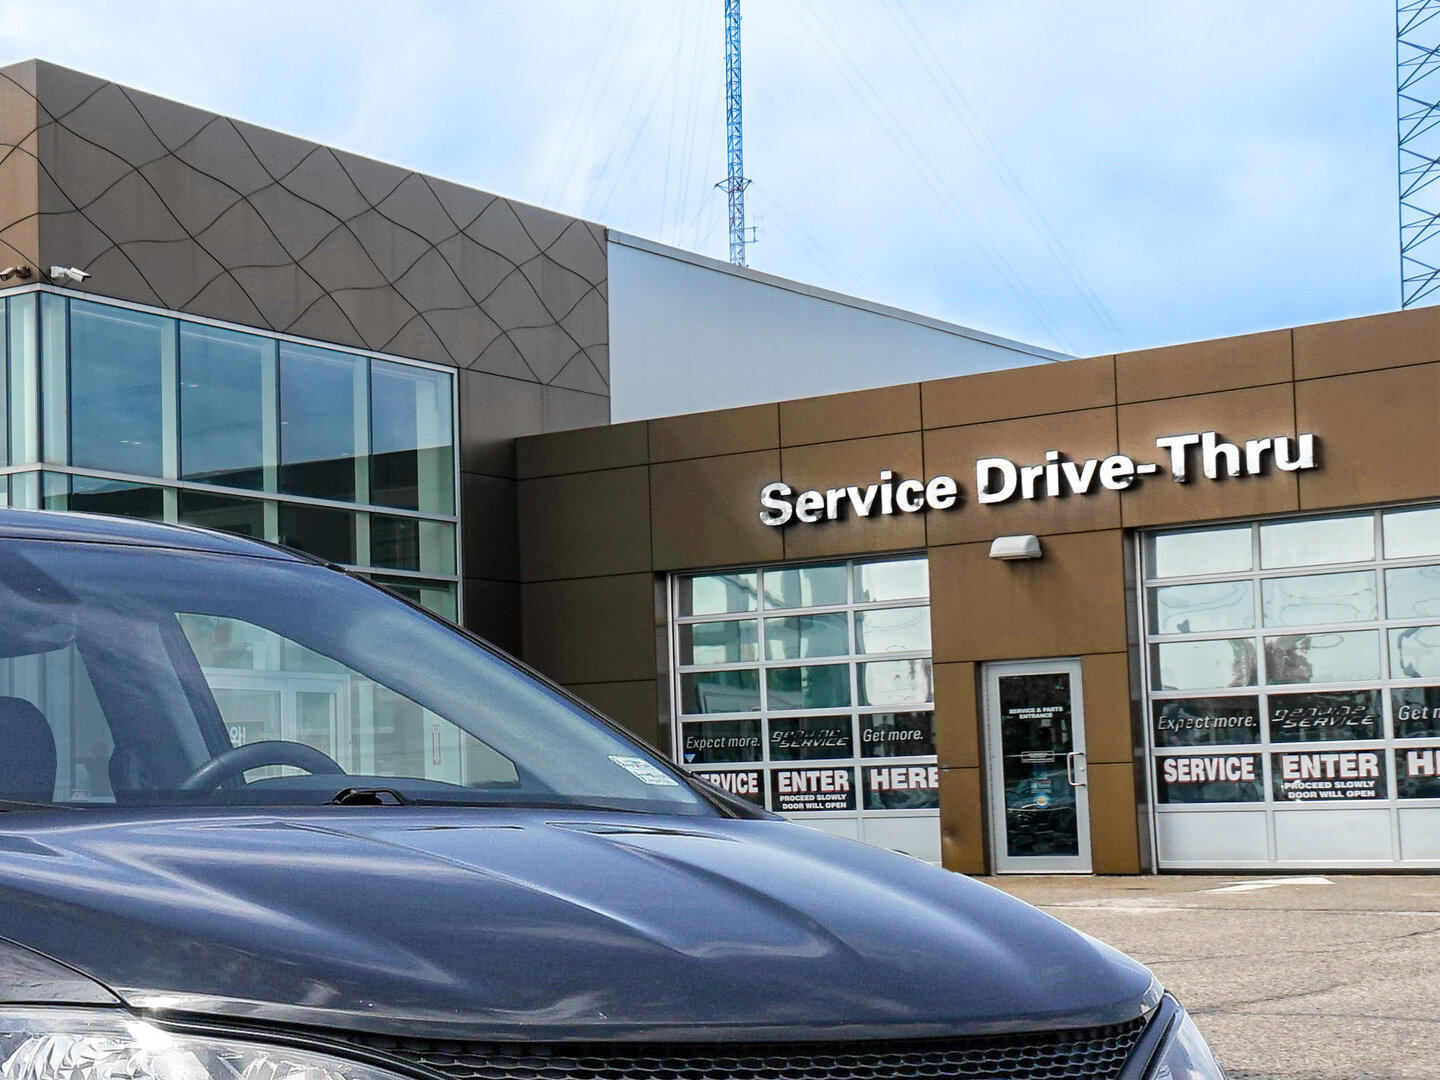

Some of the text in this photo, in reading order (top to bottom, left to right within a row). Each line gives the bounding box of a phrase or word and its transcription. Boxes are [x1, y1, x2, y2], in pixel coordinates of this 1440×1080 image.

[759, 431, 1316, 526] Service Drive-Thru
[1398, 705, 1429, 721] Get
[1158, 715, 1257, 733] Expect more.
[1282, 714, 1376, 729] SERVICE
[686, 735, 761, 751] Expect more.
[778, 736, 850, 748] SERVICE
[863, 728, 924, 743] Get more.
[1164, 756, 1256, 784] SERVICE
[1281, 752, 1380, 780] ENTER
[778, 769, 850, 793] ENTER
[870, 766, 939, 791] HERE
[1284, 780, 1376, 790] PROCEED SLOWLY
[779, 793, 847, 802] PROCEED SLOWLY
[1288, 789, 1376, 799] DOOR WILL OPEN
[782, 802, 804, 810] DOOR
